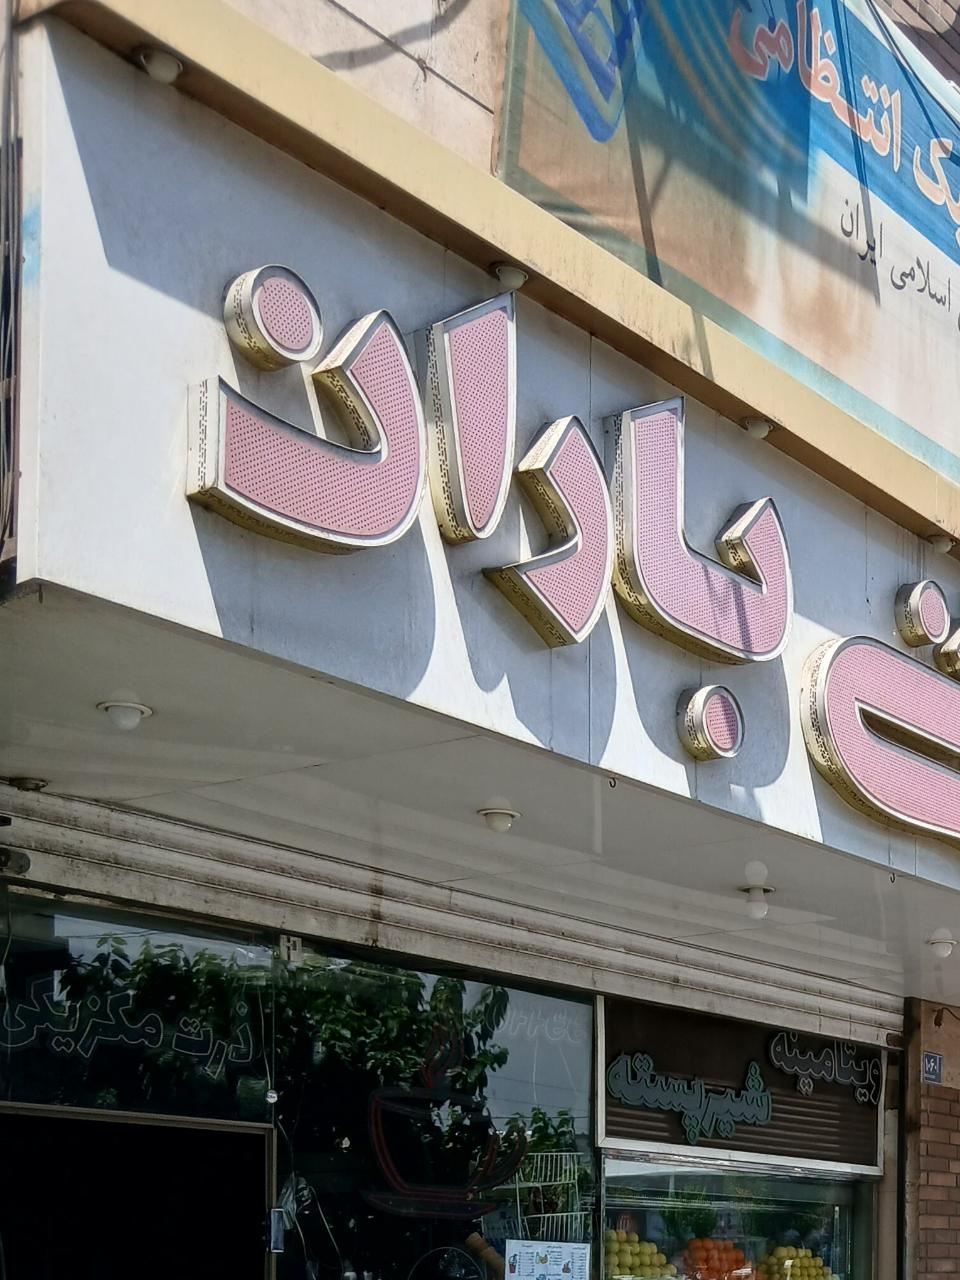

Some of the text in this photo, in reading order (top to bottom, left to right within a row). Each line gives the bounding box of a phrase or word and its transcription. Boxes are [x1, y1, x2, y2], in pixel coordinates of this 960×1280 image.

[727, 0, 901, 173] انتظامی
[840, 198, 883, 267] ایران
[890, 256, 951, 312] اسلامی
[186, 262, 795, 762] باران
[171, 1000, 254, 1079] ذرت
